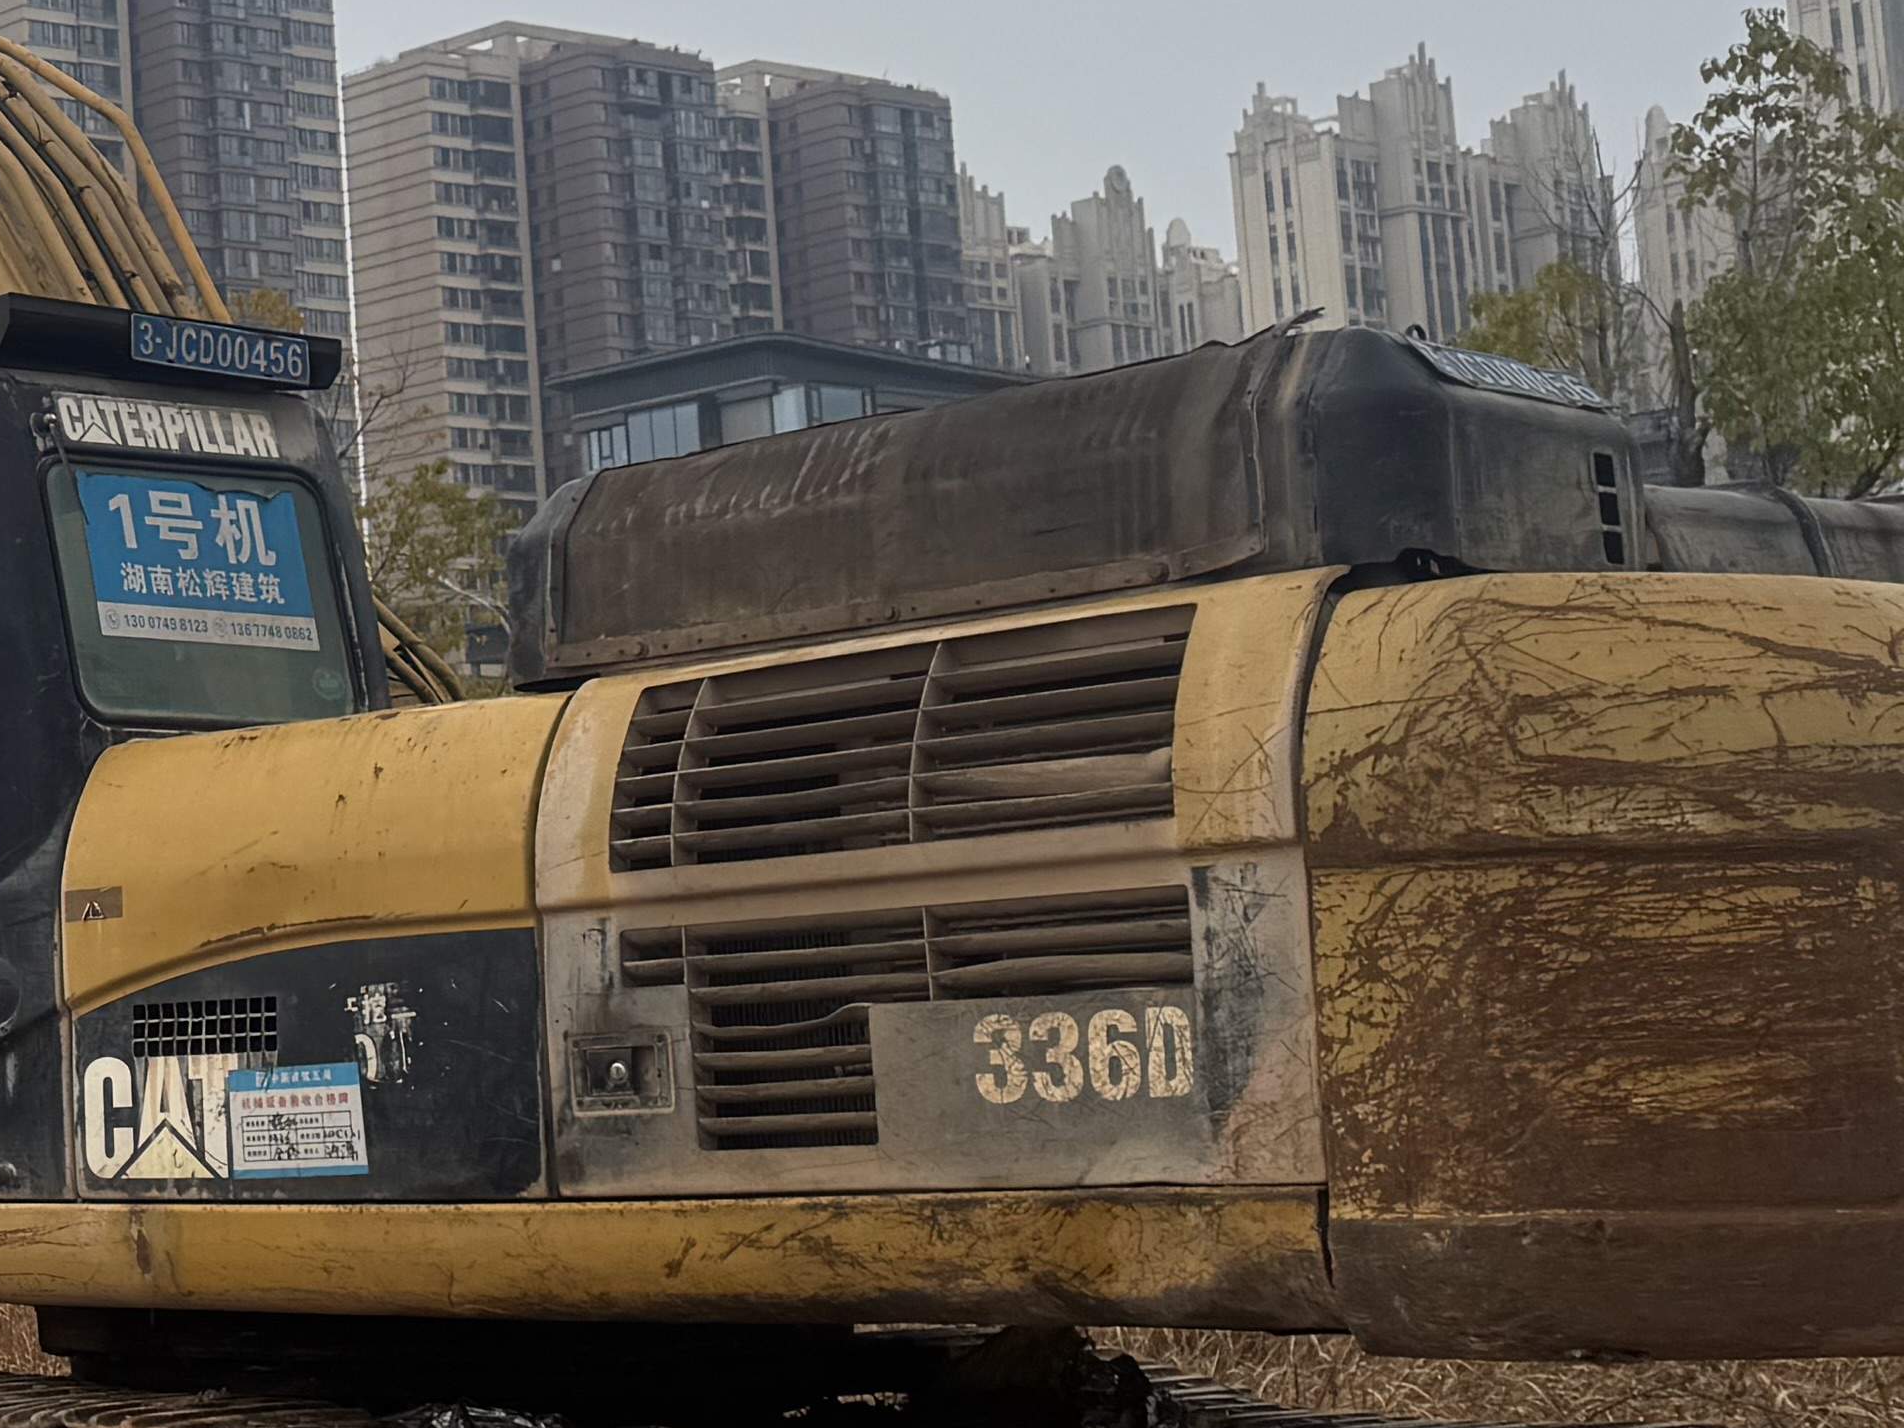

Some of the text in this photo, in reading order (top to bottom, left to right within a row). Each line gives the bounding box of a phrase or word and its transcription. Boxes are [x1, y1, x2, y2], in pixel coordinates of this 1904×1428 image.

[139, 322, 303, 378] 3-JCD00456
[57, 397, 280, 459] CATERPILLAR
[107, 489, 277, 566] 1号机
[120, 561, 286, 605] 湖南松辉建筑
[972, 1005, 1194, 1104] 336D
[83, 1054, 238, 1180] CAT
